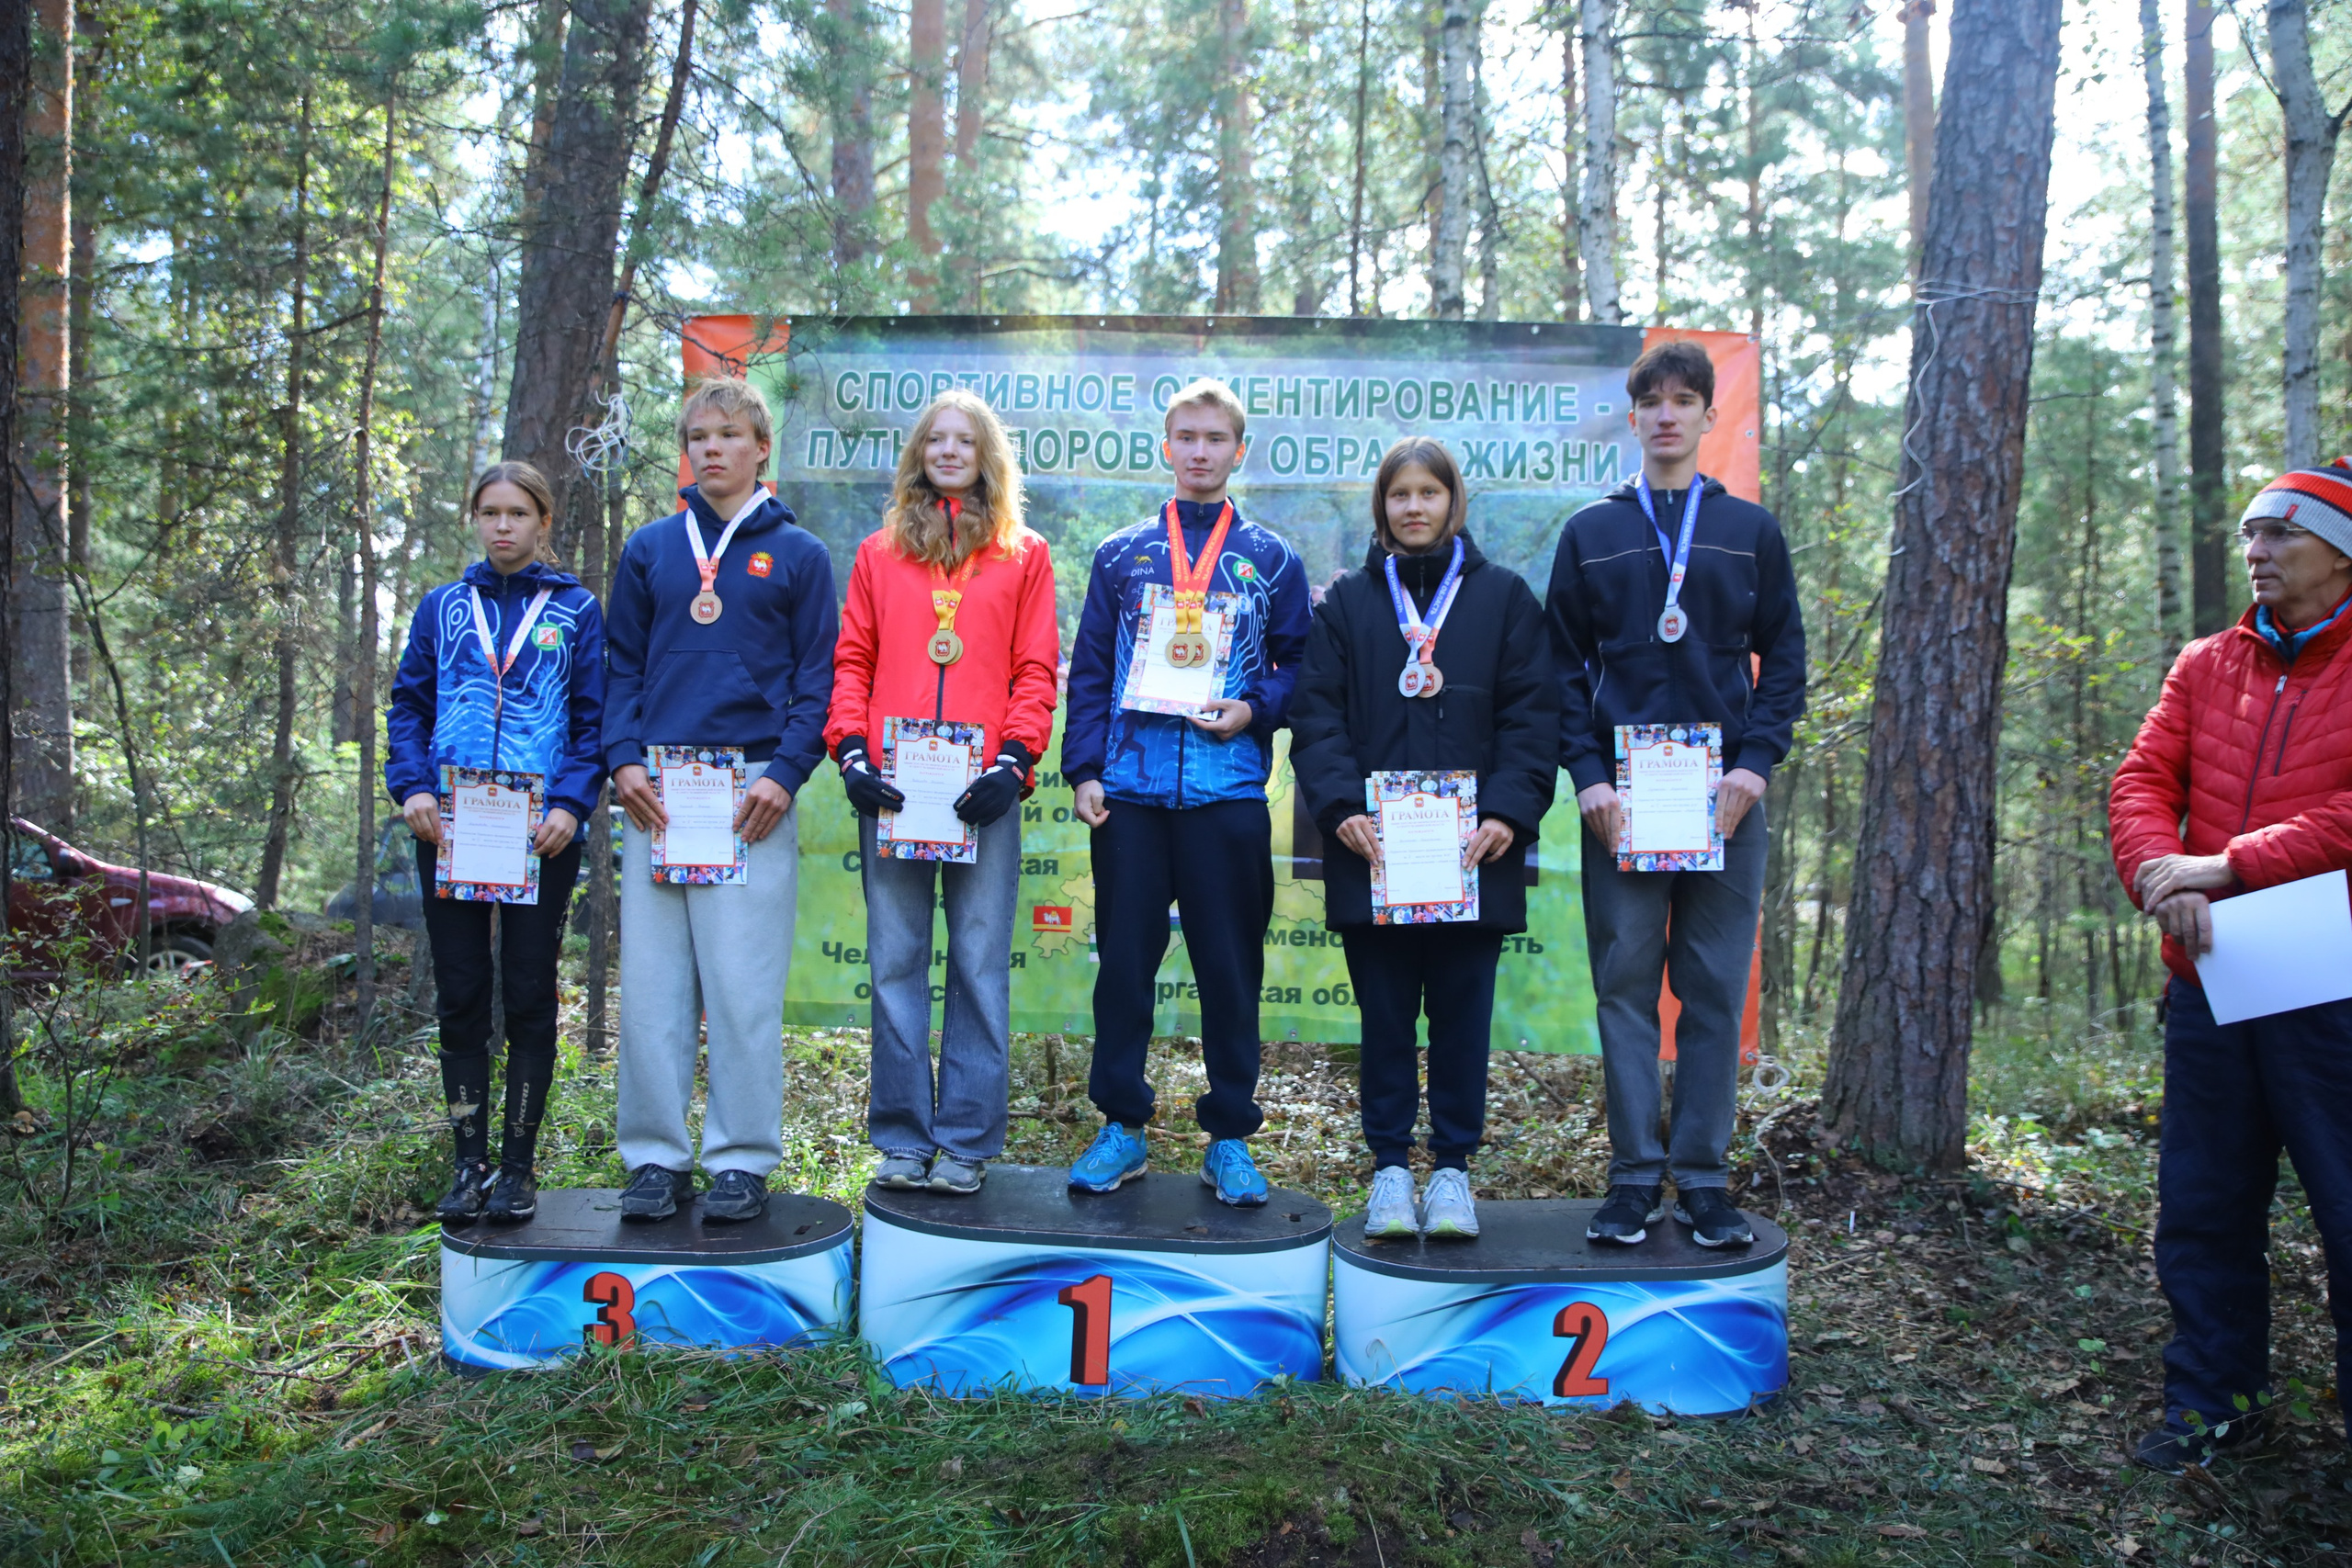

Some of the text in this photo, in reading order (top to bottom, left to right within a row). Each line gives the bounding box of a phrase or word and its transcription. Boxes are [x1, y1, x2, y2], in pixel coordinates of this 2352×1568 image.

[835, 370, 1136, 412] СПОРТИВНОЕ
[1151, 374, 1579, 423] ОЕНТИРОВАНИЕ
[1461, 440, 1622, 483] ЖИЗНИ
[904, 750, 960, 764] ГРАМОТА
[1639, 759, 1699, 770] ГРАМОТА
[671, 777, 725, 788] ГРАМОТА
[463, 796, 522, 810] ГРАМОТА
[1390, 808, 1450, 821] ГРАМОТА
[582, 1271, 636, 1351] 3
[1058, 1274, 1114, 1387] 1
[1553, 1302, 1610, 1398] 2
